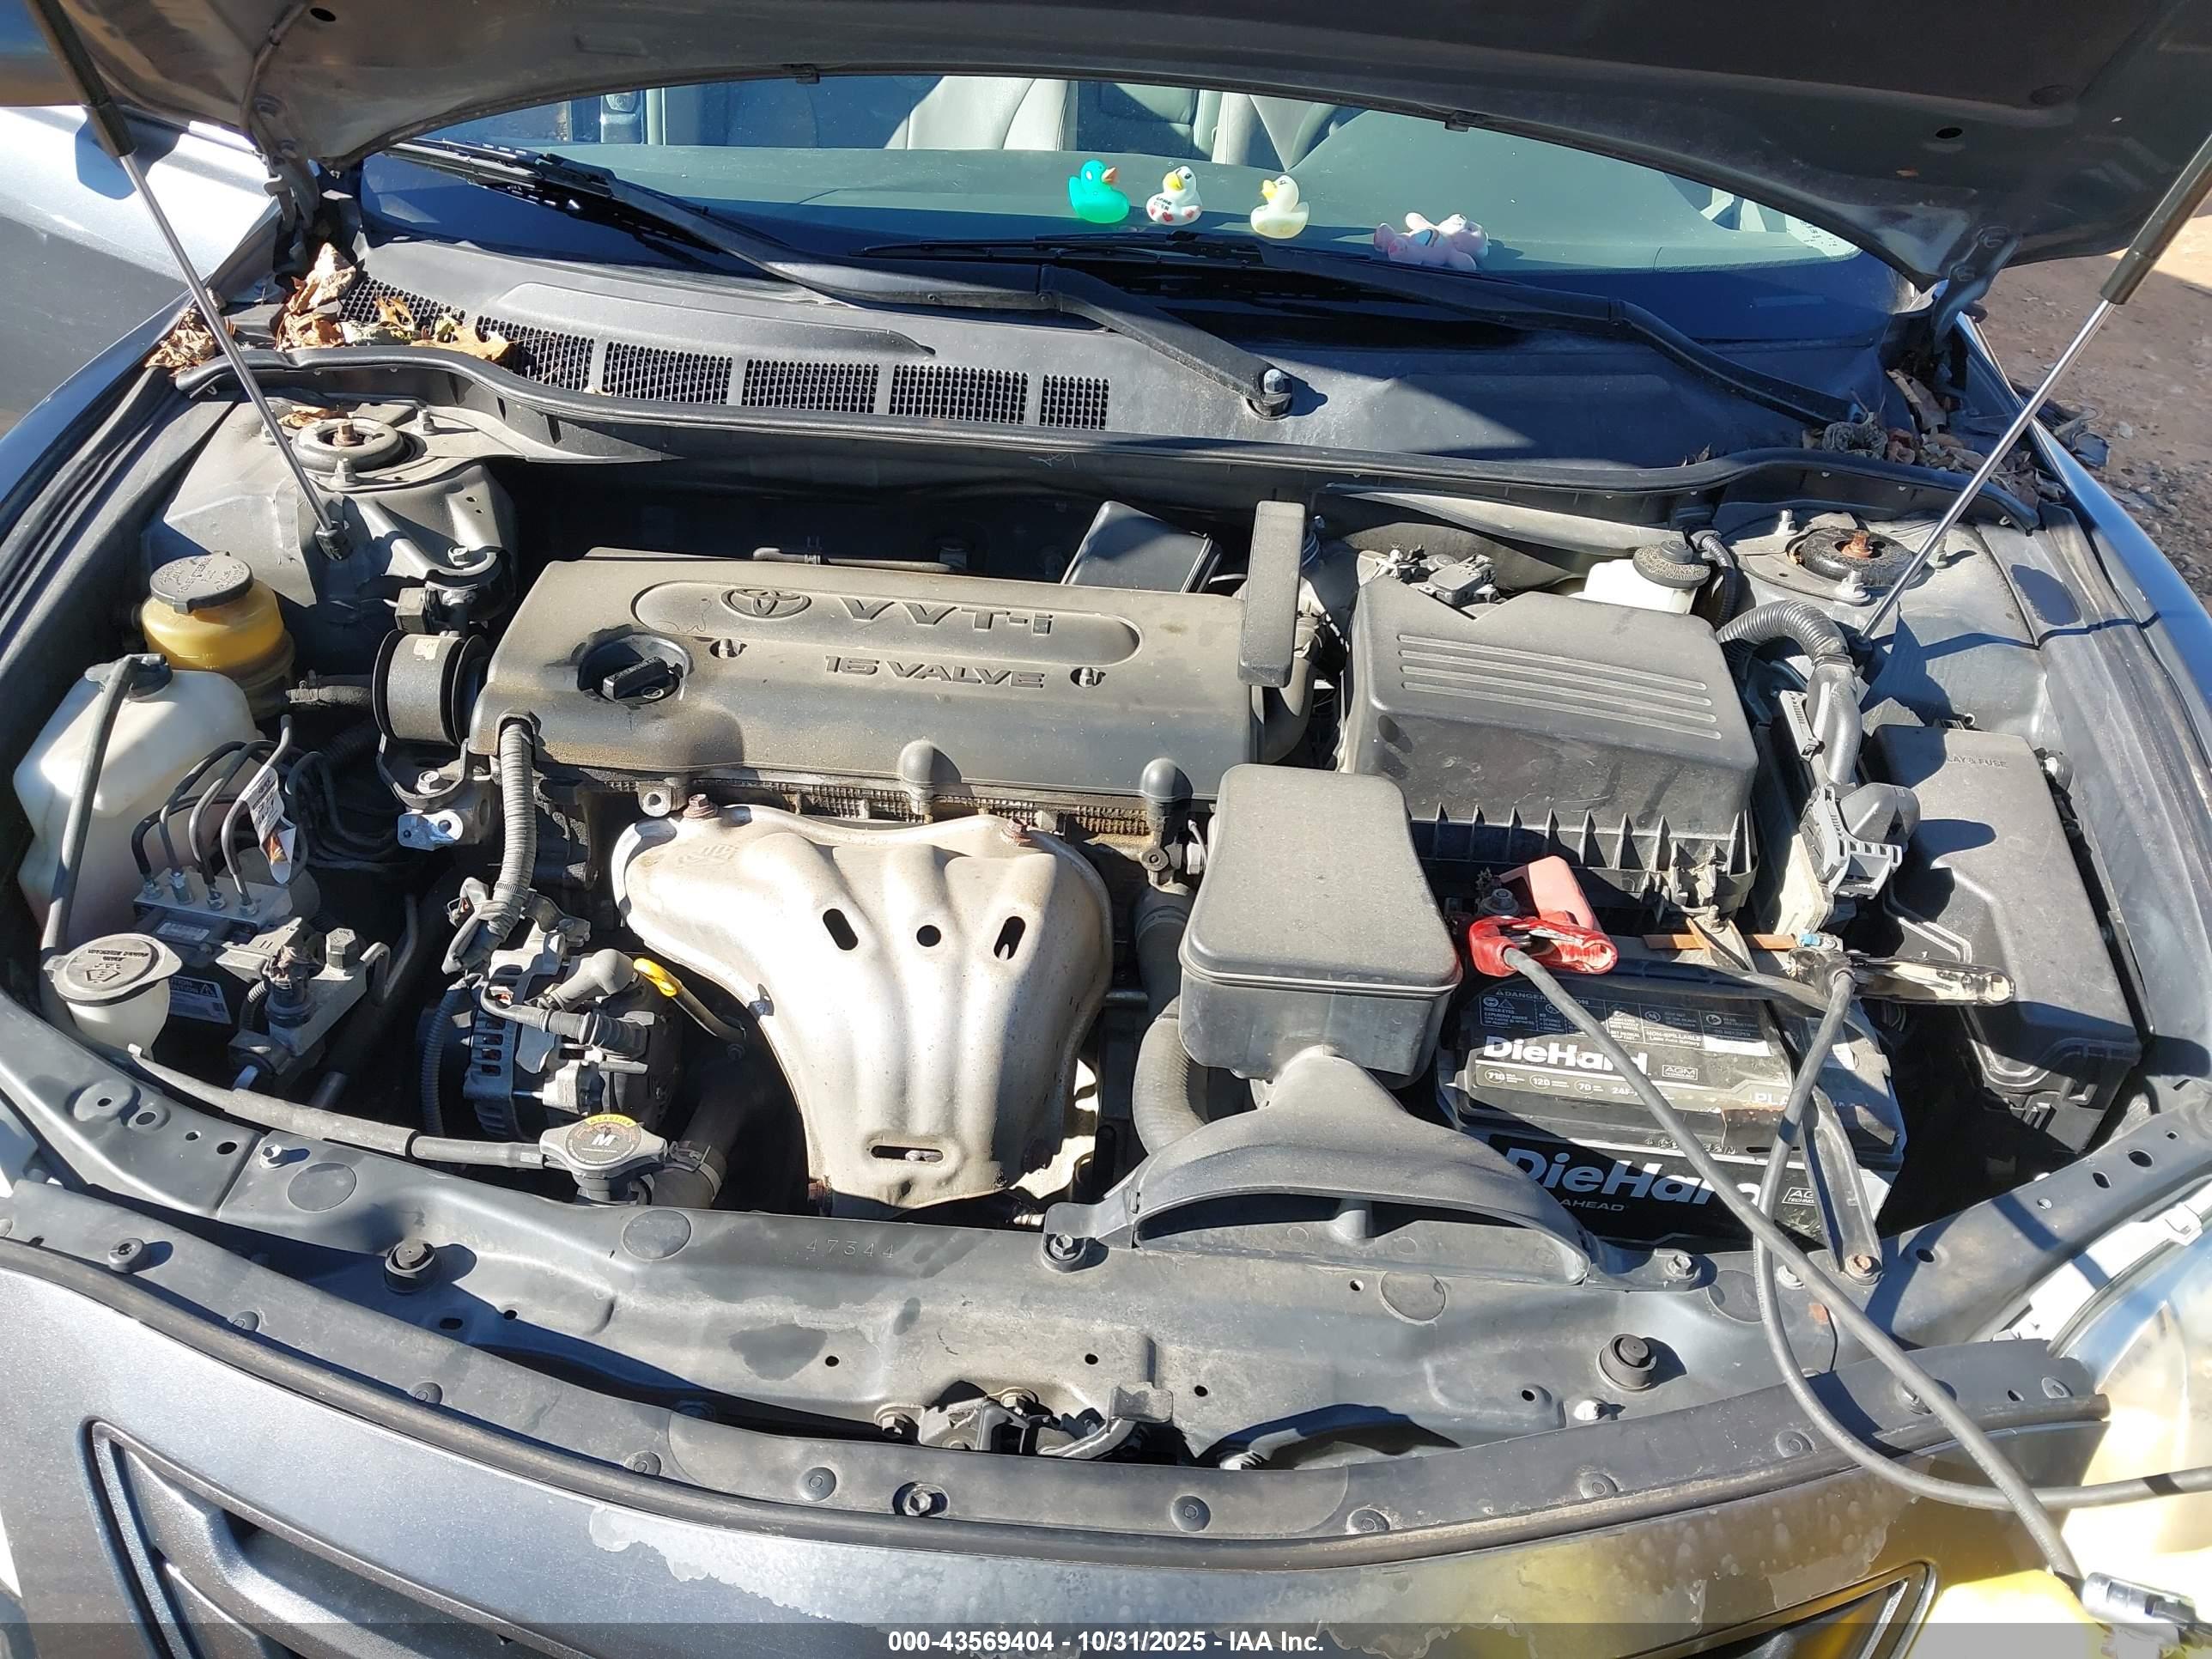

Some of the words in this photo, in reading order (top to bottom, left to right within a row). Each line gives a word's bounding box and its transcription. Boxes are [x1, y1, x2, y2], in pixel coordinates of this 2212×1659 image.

[839, 597, 1054, 635] VVT-i
[824, 655, 880, 676] 16
[887, 659, 1046, 689] VALVE
[1665, 1066, 1695, 1075] AGM
[1578, 1083, 1592, 1091] 70
[597, 1116, 633, 1126] CAUTION
[1561, 1199, 1626, 1212] AHEAD
